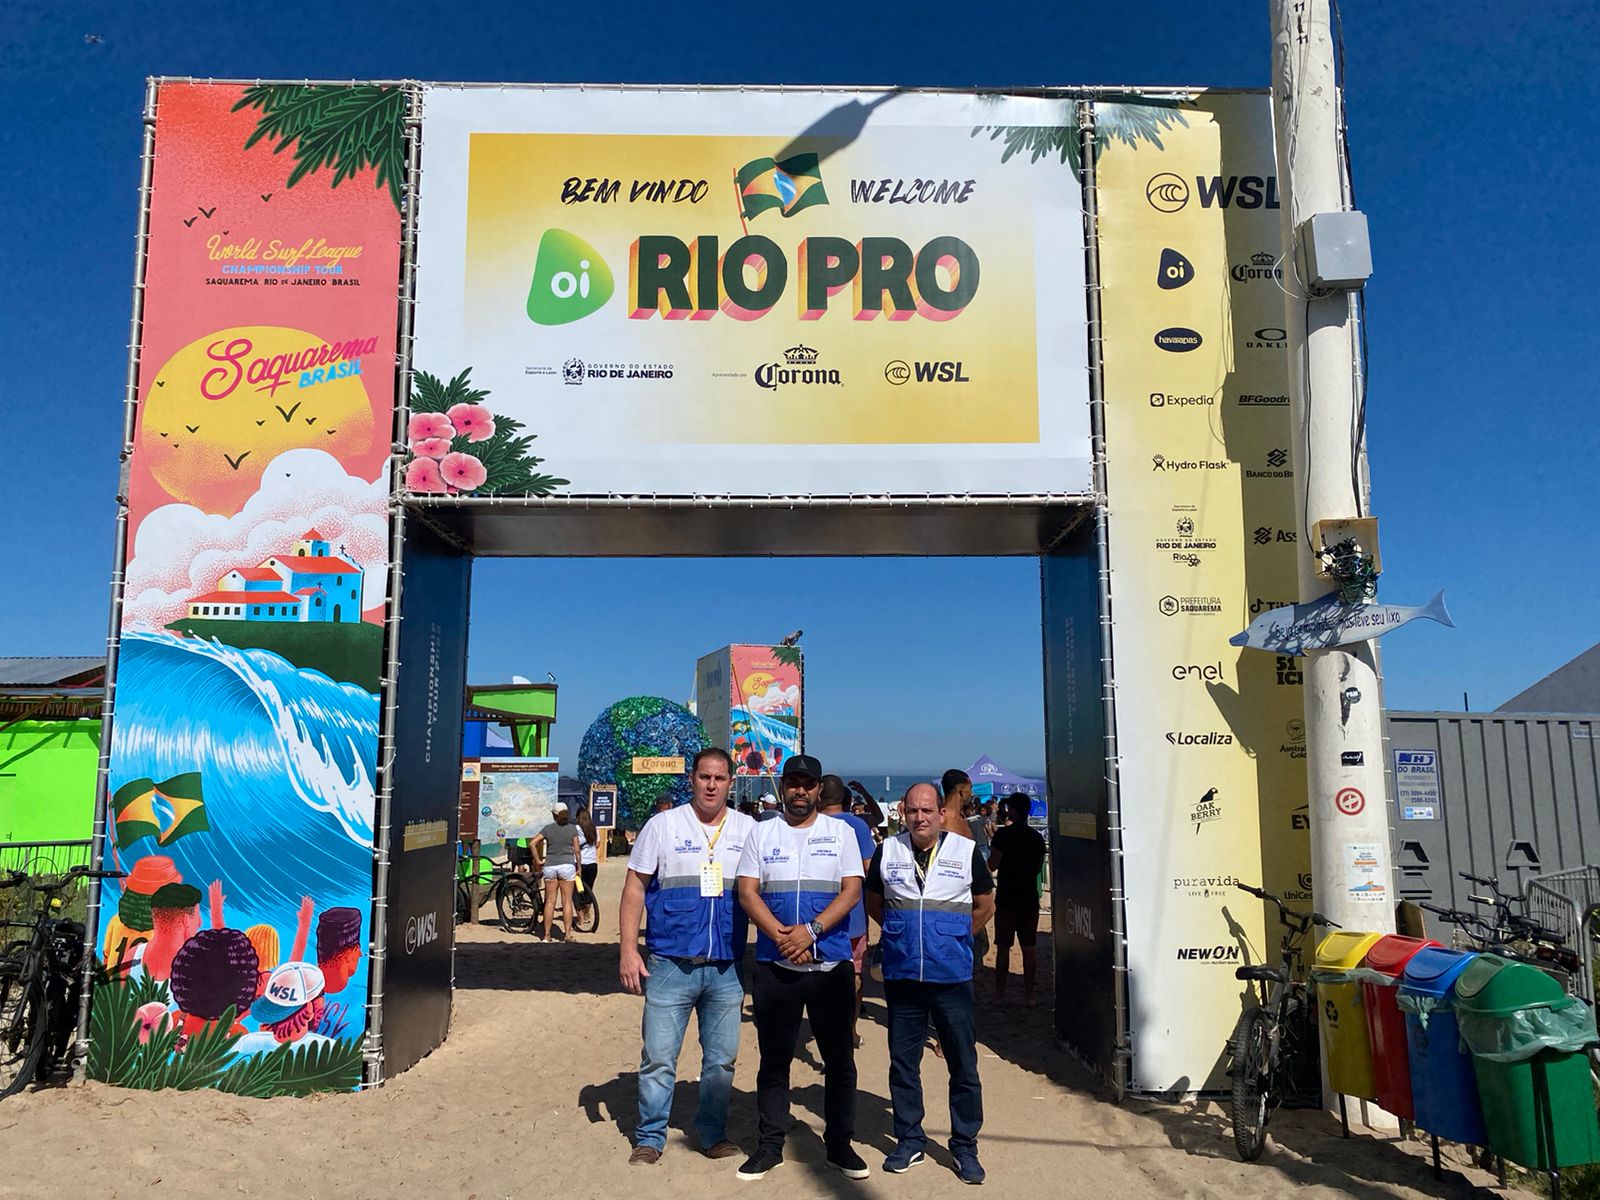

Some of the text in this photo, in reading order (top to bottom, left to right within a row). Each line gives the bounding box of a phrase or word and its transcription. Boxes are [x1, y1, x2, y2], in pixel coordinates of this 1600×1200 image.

[560, 176, 709, 205] BEM VINDO
[850, 178, 977, 205] WELCOME
[1196, 176, 1281, 209] WSL
[206, 235, 363, 268] World Surf League
[222, 265, 343, 274] CHAMPIONSHIP TOUR
[628, 235, 980, 321] RIO PRO
[1166, 261, 1185, 279] oi
[205, 278, 259, 286] SAQUAREMA
[263, 278, 278, 286] RIO
[291, 278, 327, 286] JANEIRO
[332, 278, 361, 286] BRASIL
[551, 260, 590, 299] oi
[200, 336, 378, 400] Saquarema
[298, 359, 363, 389] BRASIL
[587, 370, 674, 379] RIO DE JANEIRO
[755, 363, 841, 391] Corona
[914, 361, 970, 382] WSL
[1167, 395, 1214, 407] Expedia
[1166, 460, 1227, 470] Hydro Flask
[1246, 470, 1272, 478] BANCO
[1180, 597, 1222, 605] PREFEITURA
[1371, 613, 1385, 627] seu
[1386, 608, 1400, 625] lixo
[1172, 661, 1224, 680] enel
[1178, 732, 1233, 745] Localiza
[642, 758, 677, 770] Corona
[1411, 766, 1435, 774] BRASIL
[1191, 808, 1222, 821] BERRY
[1196, 802, 1215, 812] OAK
[1173, 876, 1240, 889] puravida
[417, 911, 438, 947] WSL
[1074, 904, 1095, 941] WSL
[270, 983, 298, 1001] WSL
